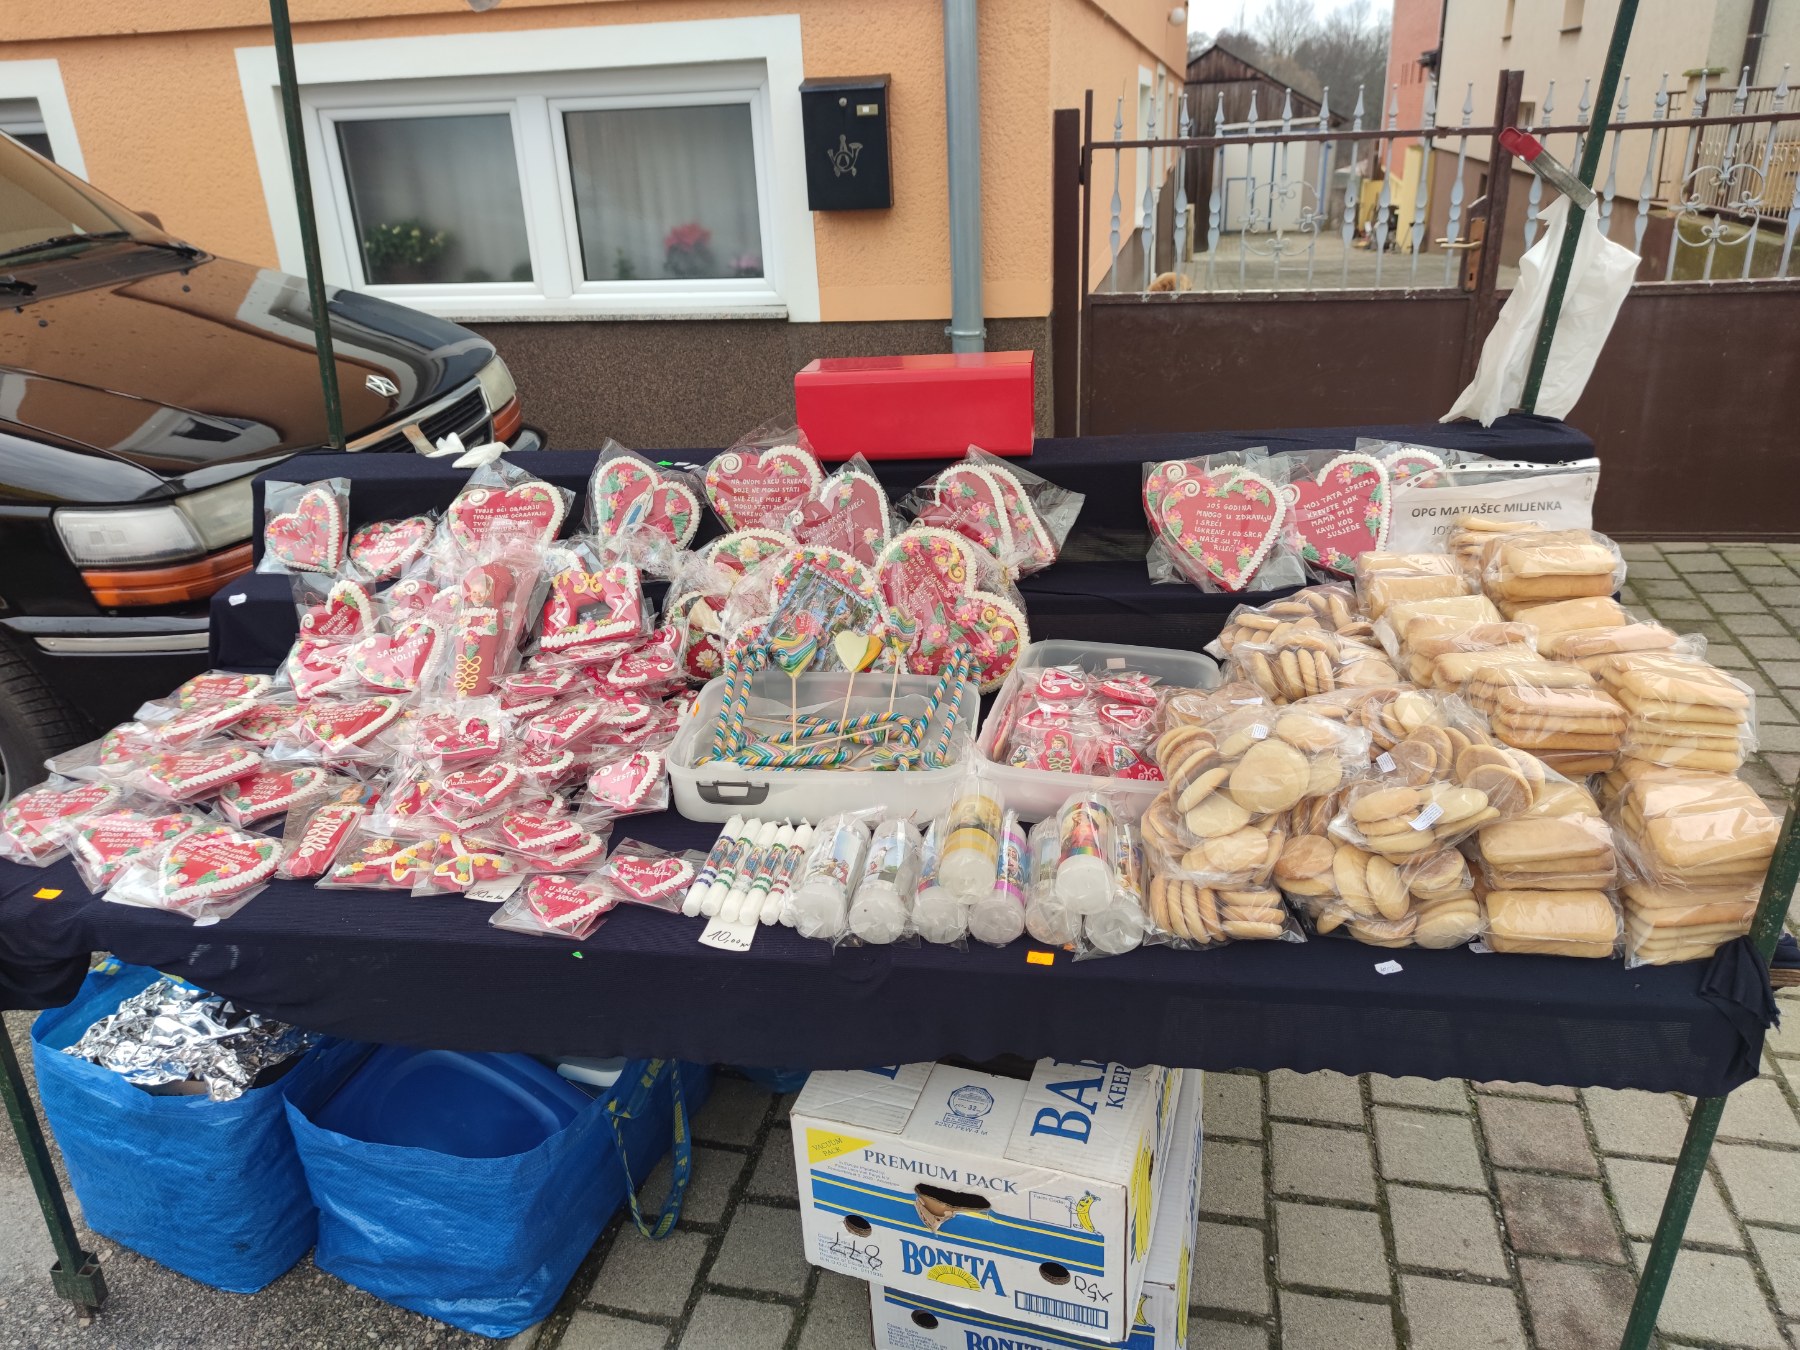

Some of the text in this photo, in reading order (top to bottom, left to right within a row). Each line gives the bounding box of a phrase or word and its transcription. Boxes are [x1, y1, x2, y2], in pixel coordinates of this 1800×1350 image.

[1303, 477, 1376, 511] MOJ TATA SPREMA
[1206, 500, 1252, 511] JOŠ GODINA
[1306, 494, 1359, 519] KREVETE DOK
[1411, 507, 1437, 518] OPG
[1503, 501, 1562, 512] MILJENKA
[1196, 510, 1222, 519] MNOGO
[1311, 506, 1355, 527] MAMA PIJE
[1194, 526, 1226, 536] ISKRENE
[1315, 517, 1354, 535] KAVU KOD
[1326, 522, 1361, 539] SUSJEDE
[376, 635, 429, 659] SAMO TEBE
[391, 648, 421, 664] VOLIM
[550, 710, 582, 724] UNUKU
[610, 768, 640, 784] SESTRI
[556, 886, 581, 897] SRCU
[556, 894, 586, 905] NOSIM
[1105, 1065, 1132, 1110] KEEP
[967, 1104, 977, 1112] 32
[1030, 1056, 1110, 1145] BA
[811, 1137, 844, 1152] VACUUM
[822, 1147, 842, 1157] PACK
[864, 1149, 960, 1183] PREMIUM
[966, 1173, 1019, 1196] PACK
[899, 1238, 1008, 1298] BONITA
